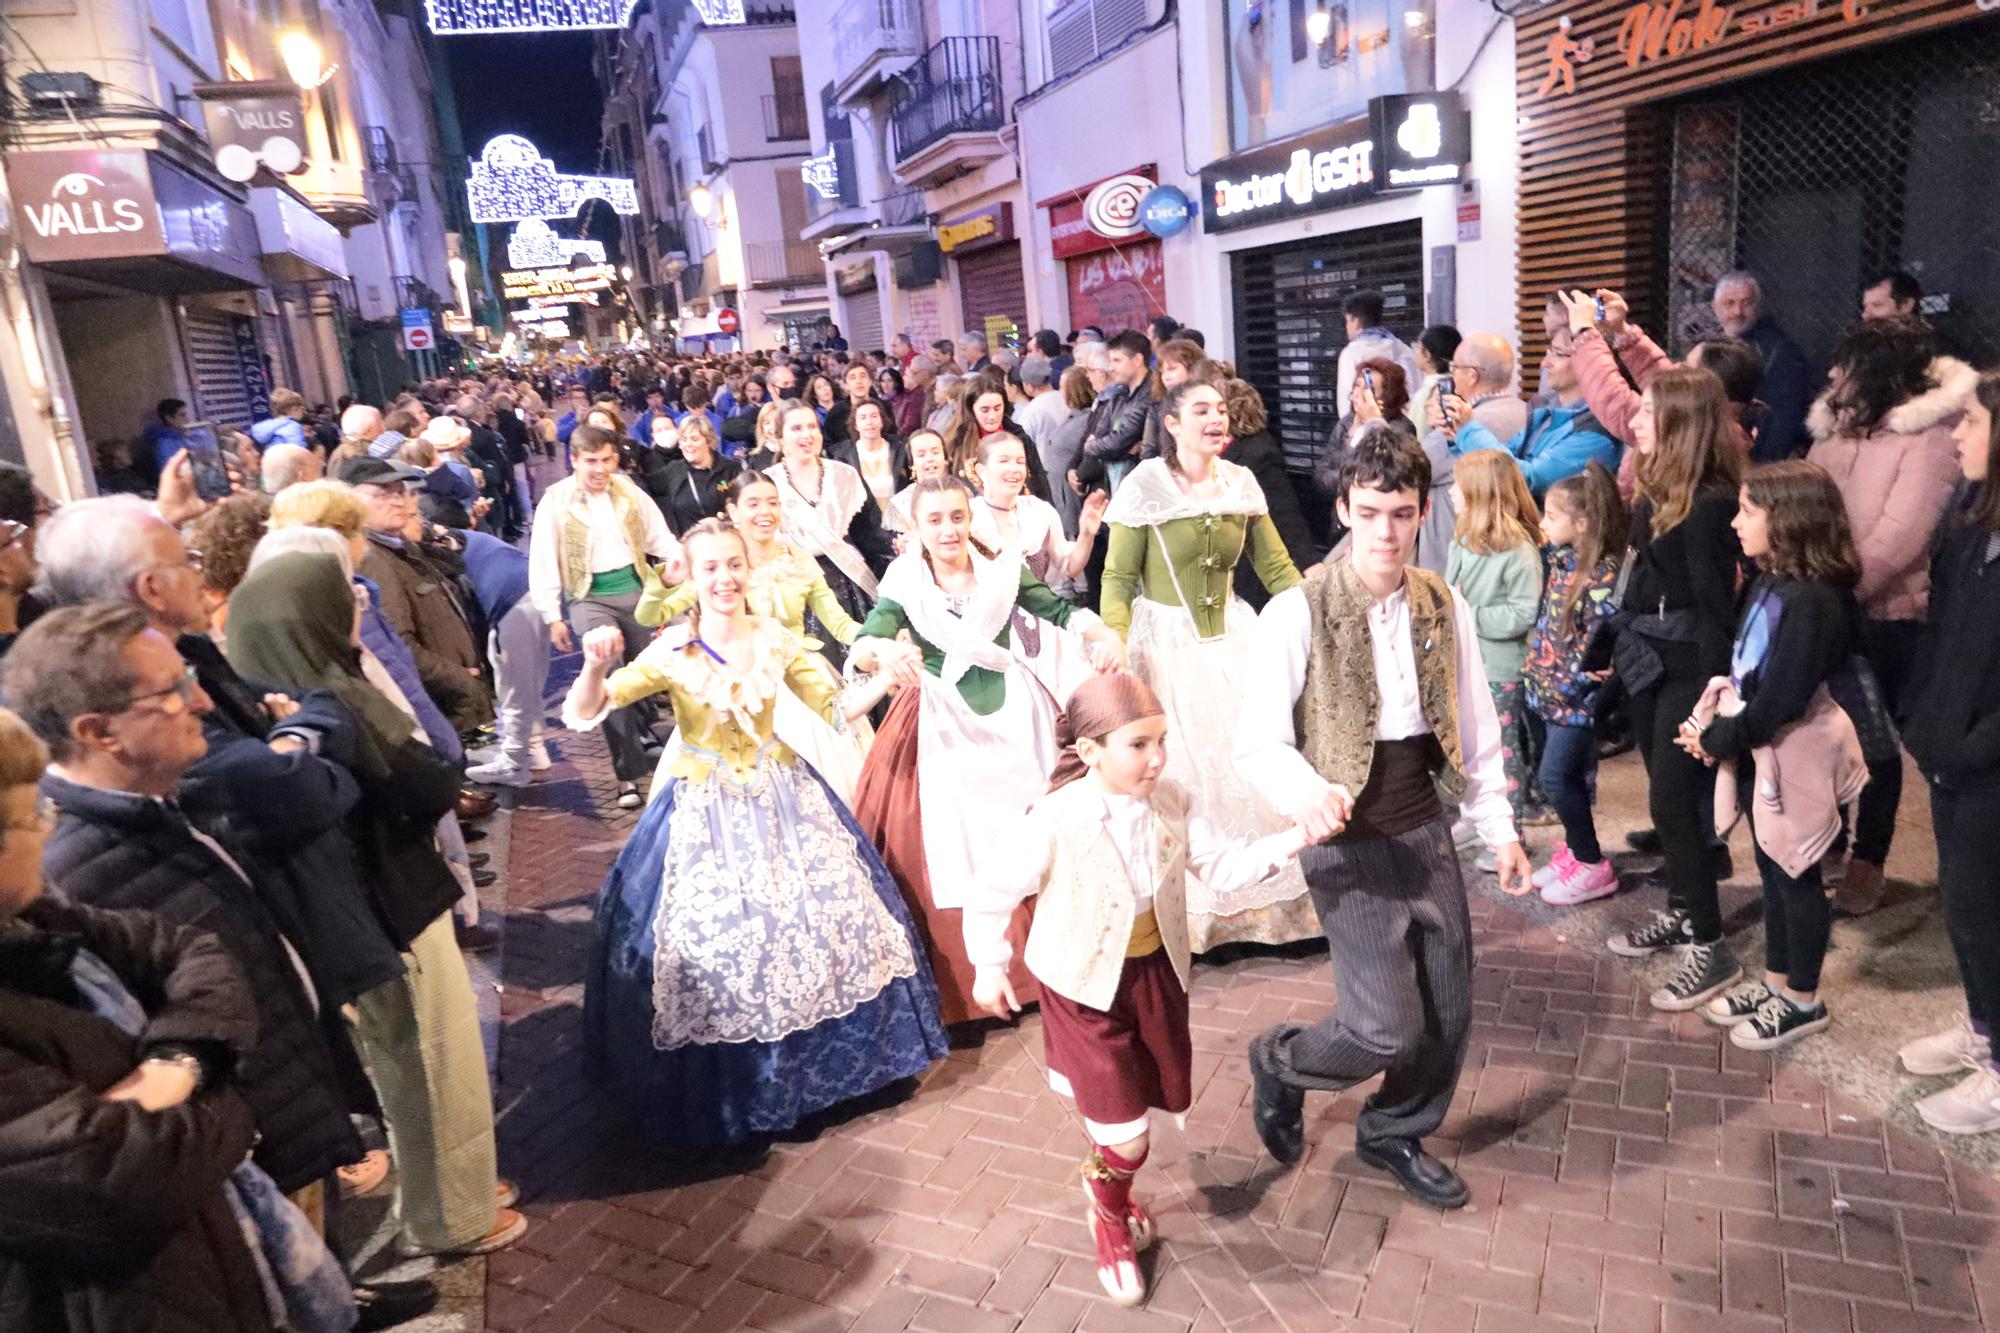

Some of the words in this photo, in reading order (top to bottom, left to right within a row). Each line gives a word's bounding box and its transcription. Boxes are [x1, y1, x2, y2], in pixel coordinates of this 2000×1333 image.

[1617, 0, 1735, 69] Wok
[234, 110, 294, 130] VALLS
[1215, 173, 1285, 217] Doctor
[24, 199, 144, 237] VALLS
